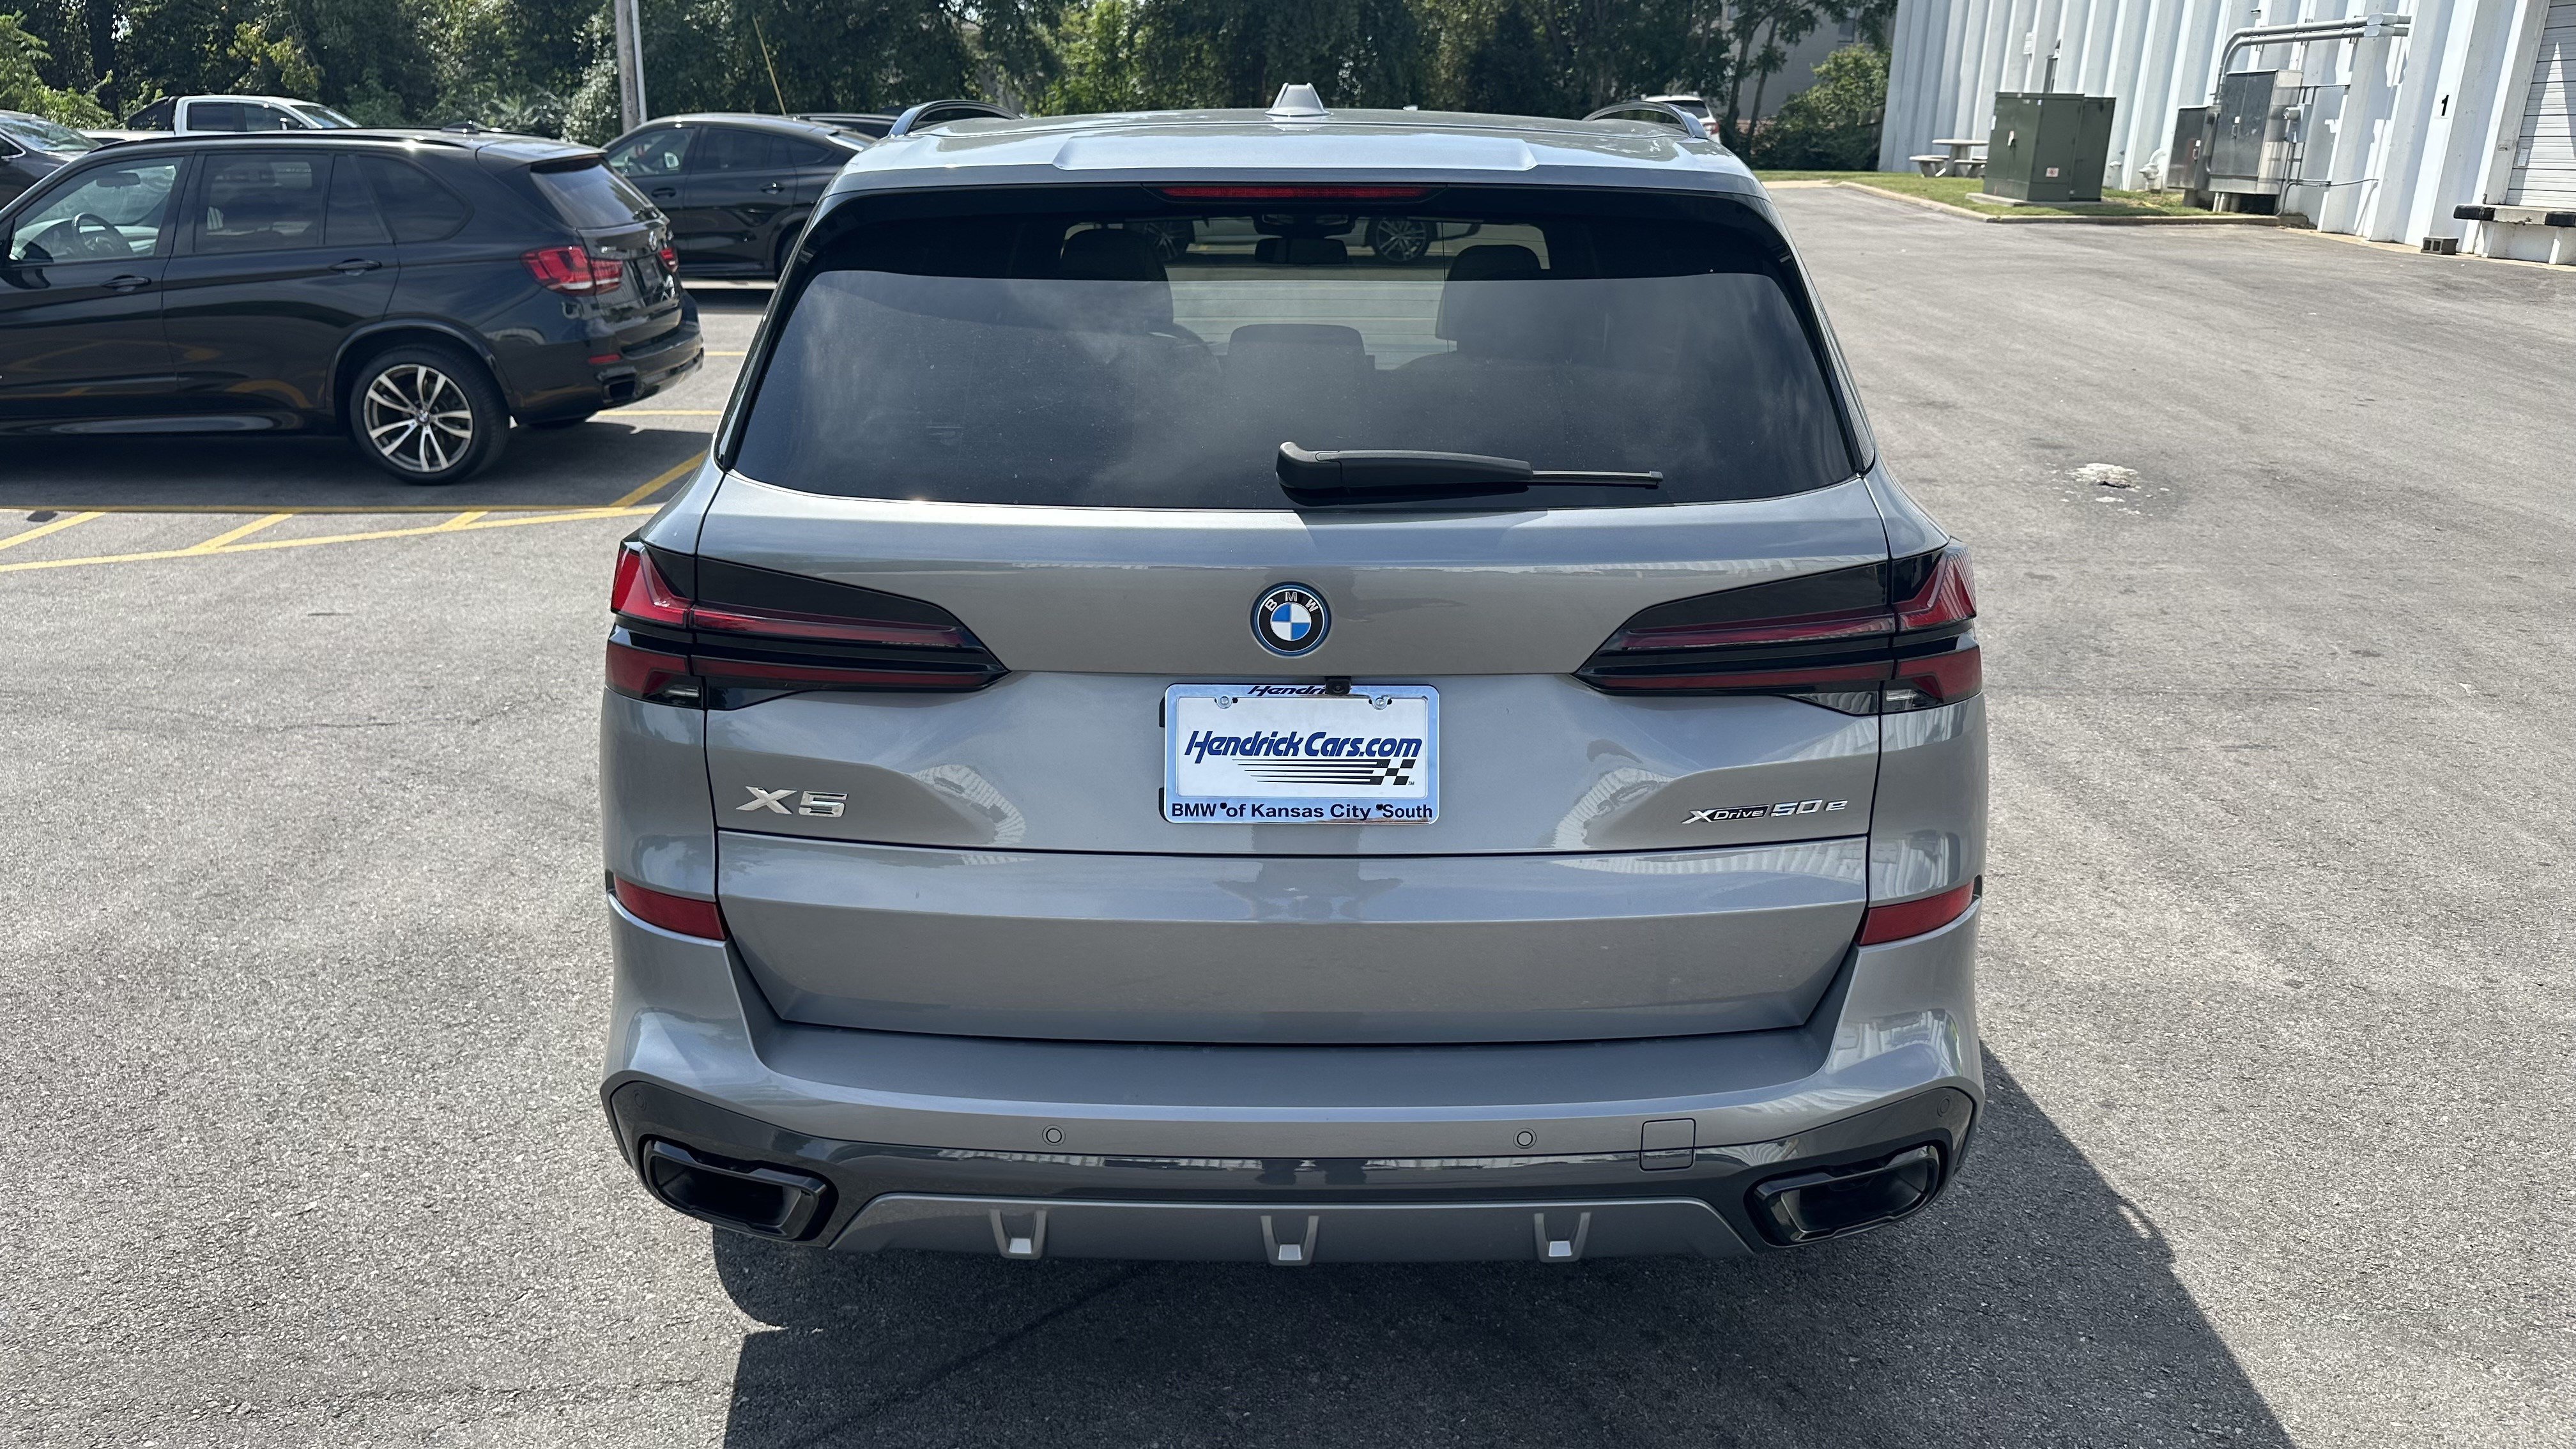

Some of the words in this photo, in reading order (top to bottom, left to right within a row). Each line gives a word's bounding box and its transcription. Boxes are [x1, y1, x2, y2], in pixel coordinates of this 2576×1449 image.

[2441, 95, 2450, 116] 1
[1264, 591, 1319, 612] BMW
[1248, 686, 1329, 697] Hendri
[735, 786, 848, 818] X5
[1172, 803, 1216, 817] BMW
[1225, 803, 1246, 818] of
[1251, 803, 1324, 818] Kansas
[1330, 804, 1372, 821] City
[1382, 804, 1432, 818] South
